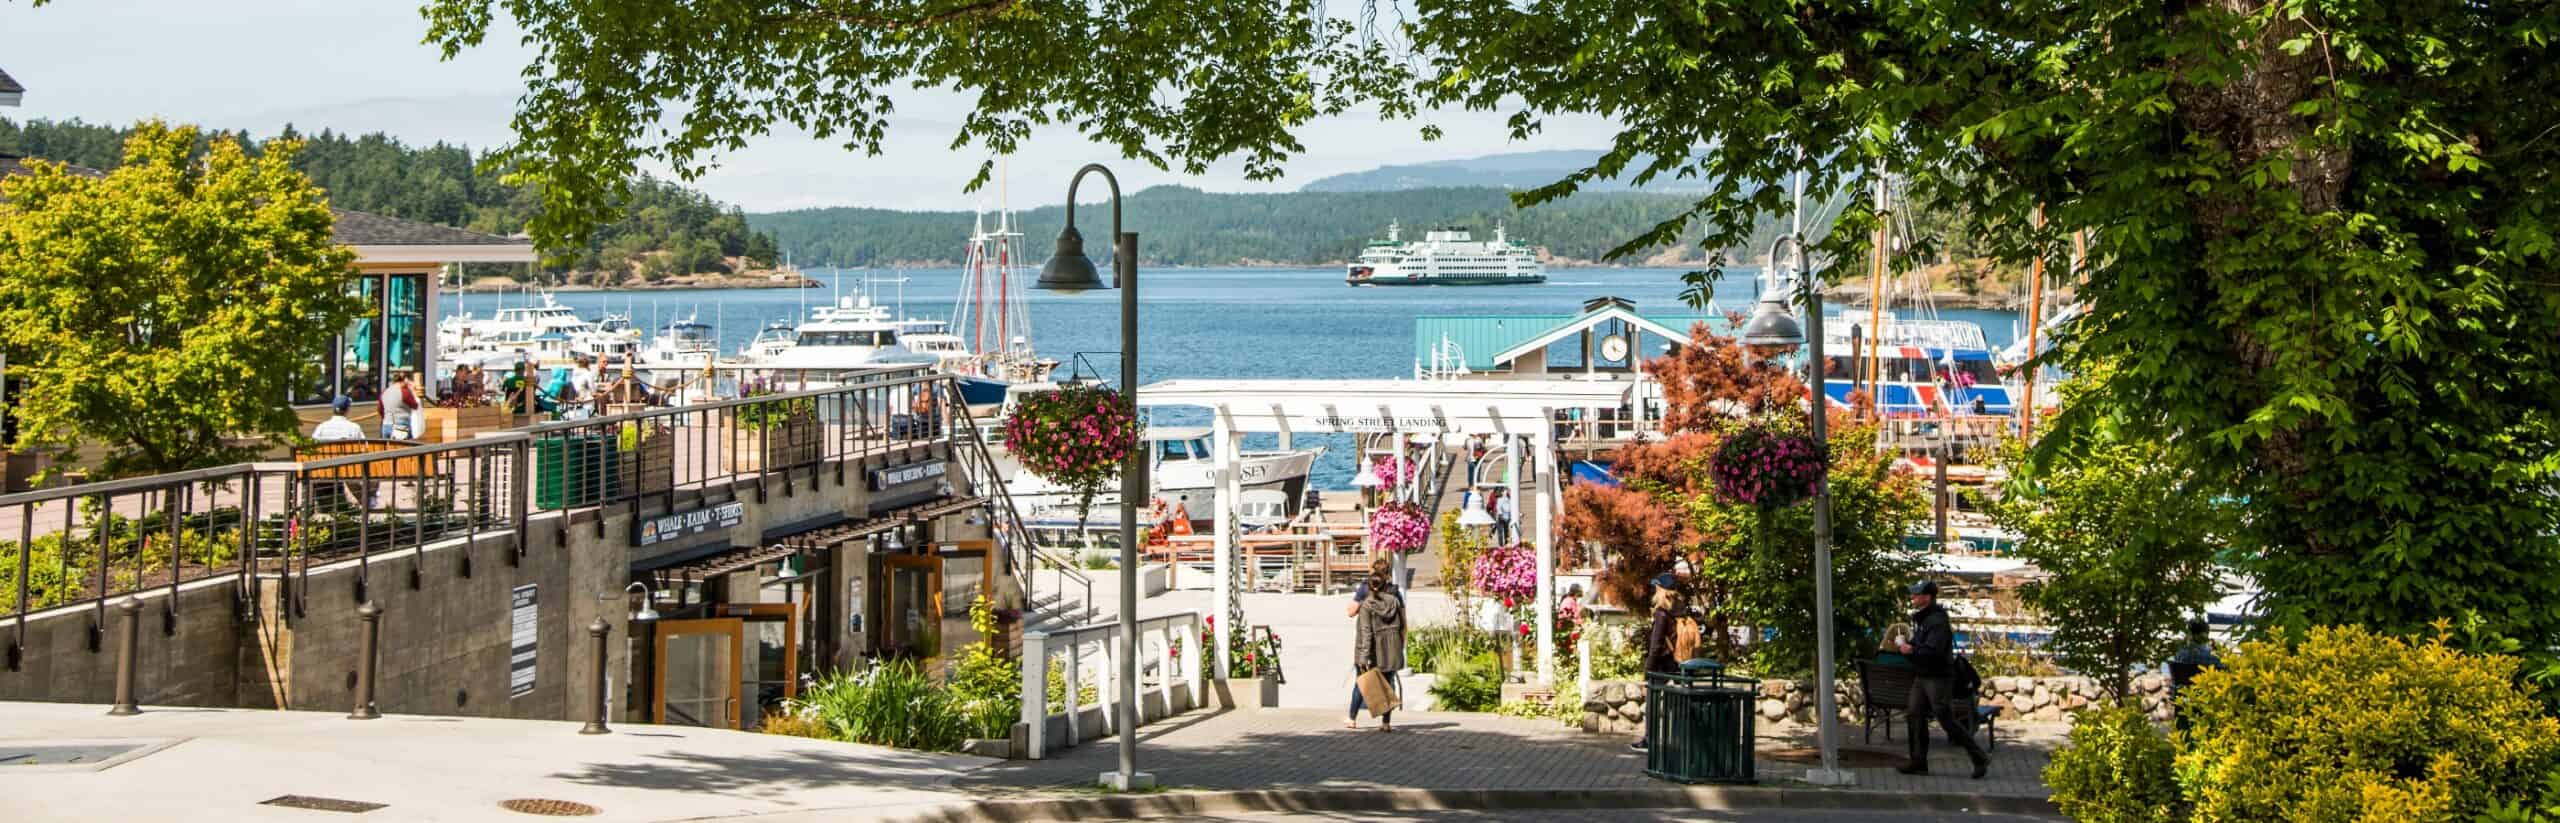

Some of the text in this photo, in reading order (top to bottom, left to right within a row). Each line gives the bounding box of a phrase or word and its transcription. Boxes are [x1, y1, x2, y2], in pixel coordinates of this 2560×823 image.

[1315, 416, 1446, 427] SPRING STREET LANDING
[657, 515, 683, 534] WHALE
[687, 509, 711, 527] KAYAK
